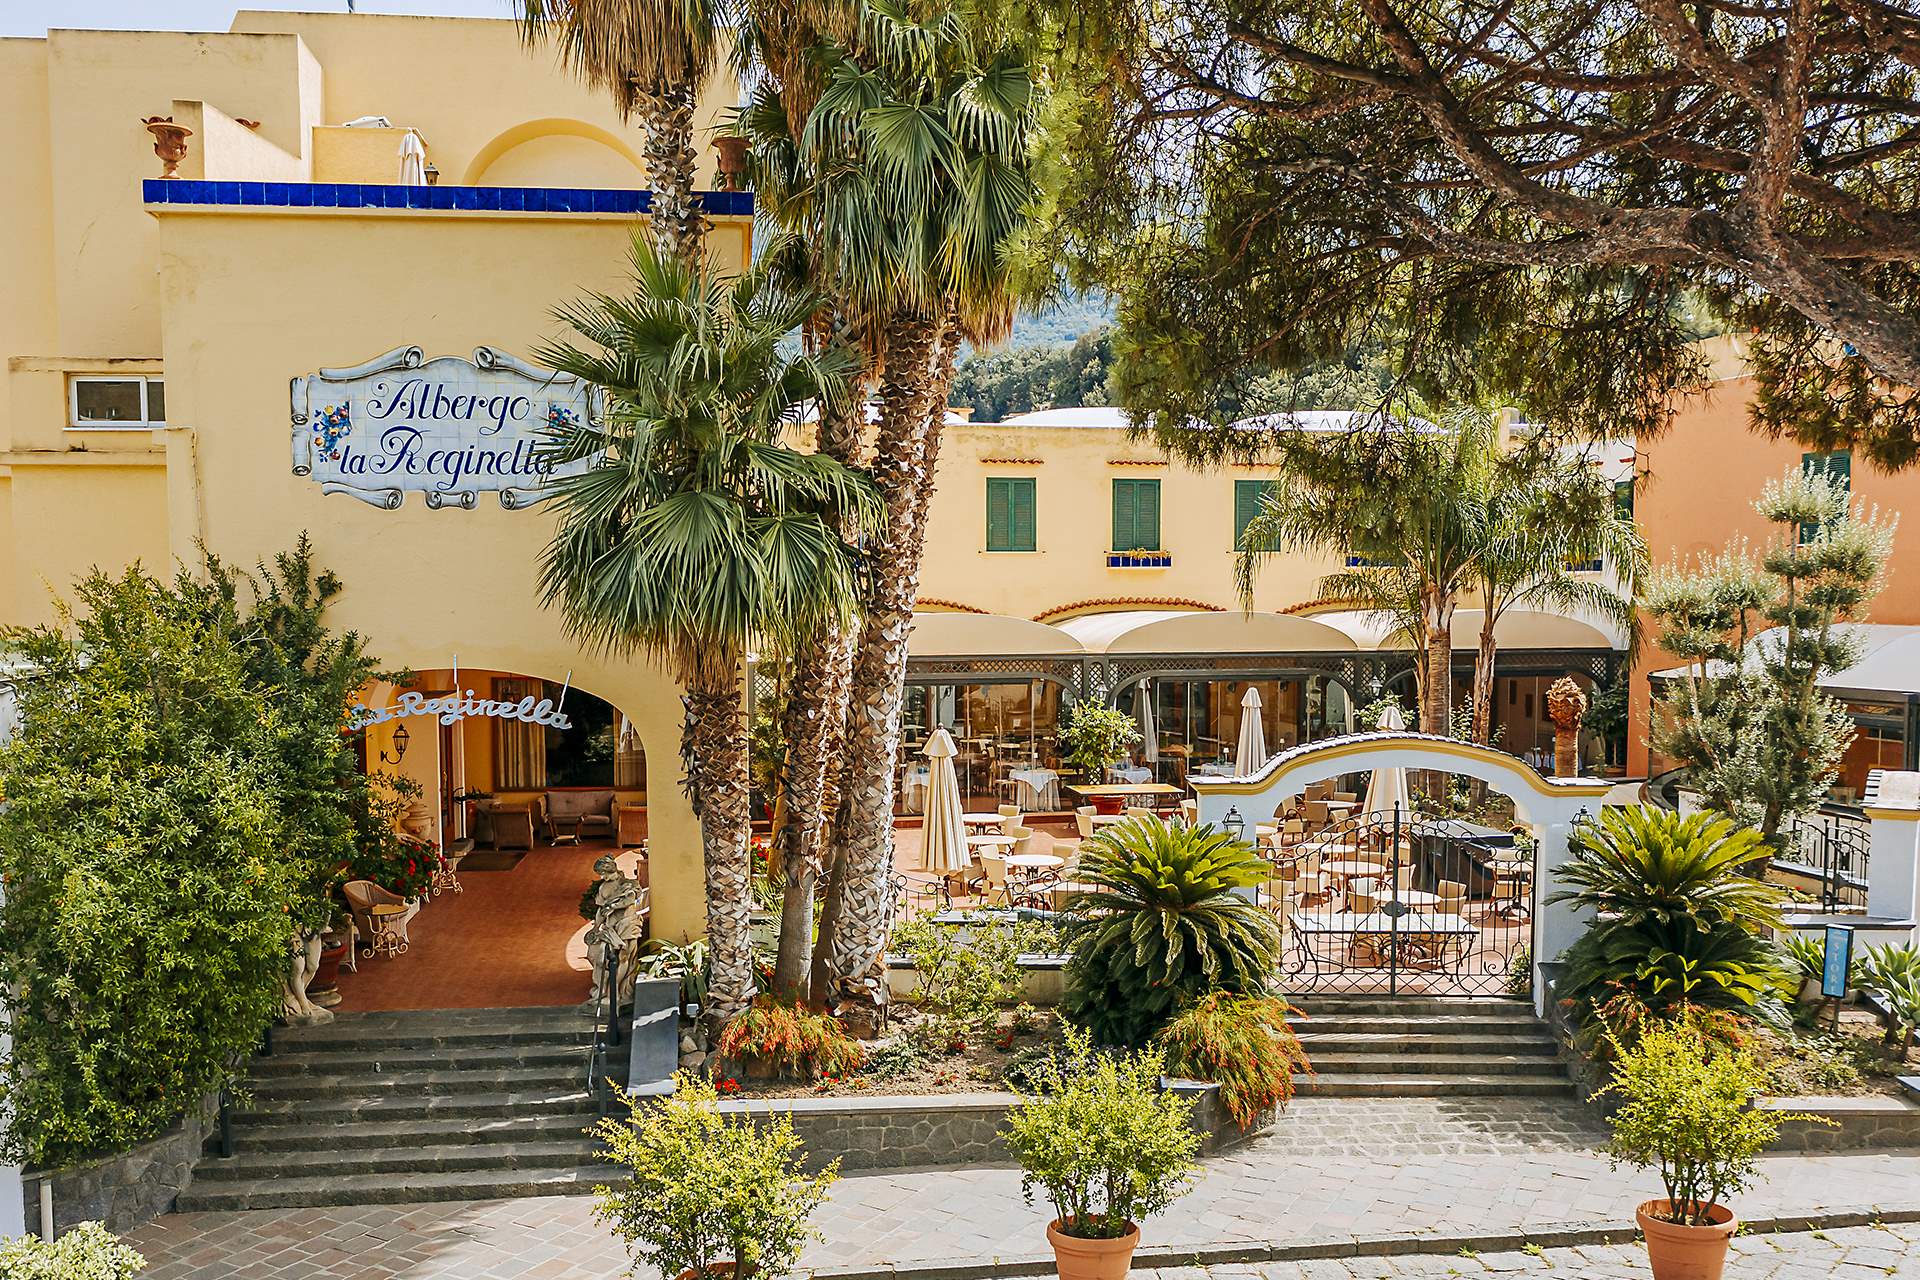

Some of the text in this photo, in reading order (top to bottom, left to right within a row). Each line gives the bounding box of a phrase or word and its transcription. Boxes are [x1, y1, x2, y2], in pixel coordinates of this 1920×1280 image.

[366, 378, 530, 436] Albergo
[340, 425, 558, 490] la Reginella
[397, 689, 572, 730] Reginella
